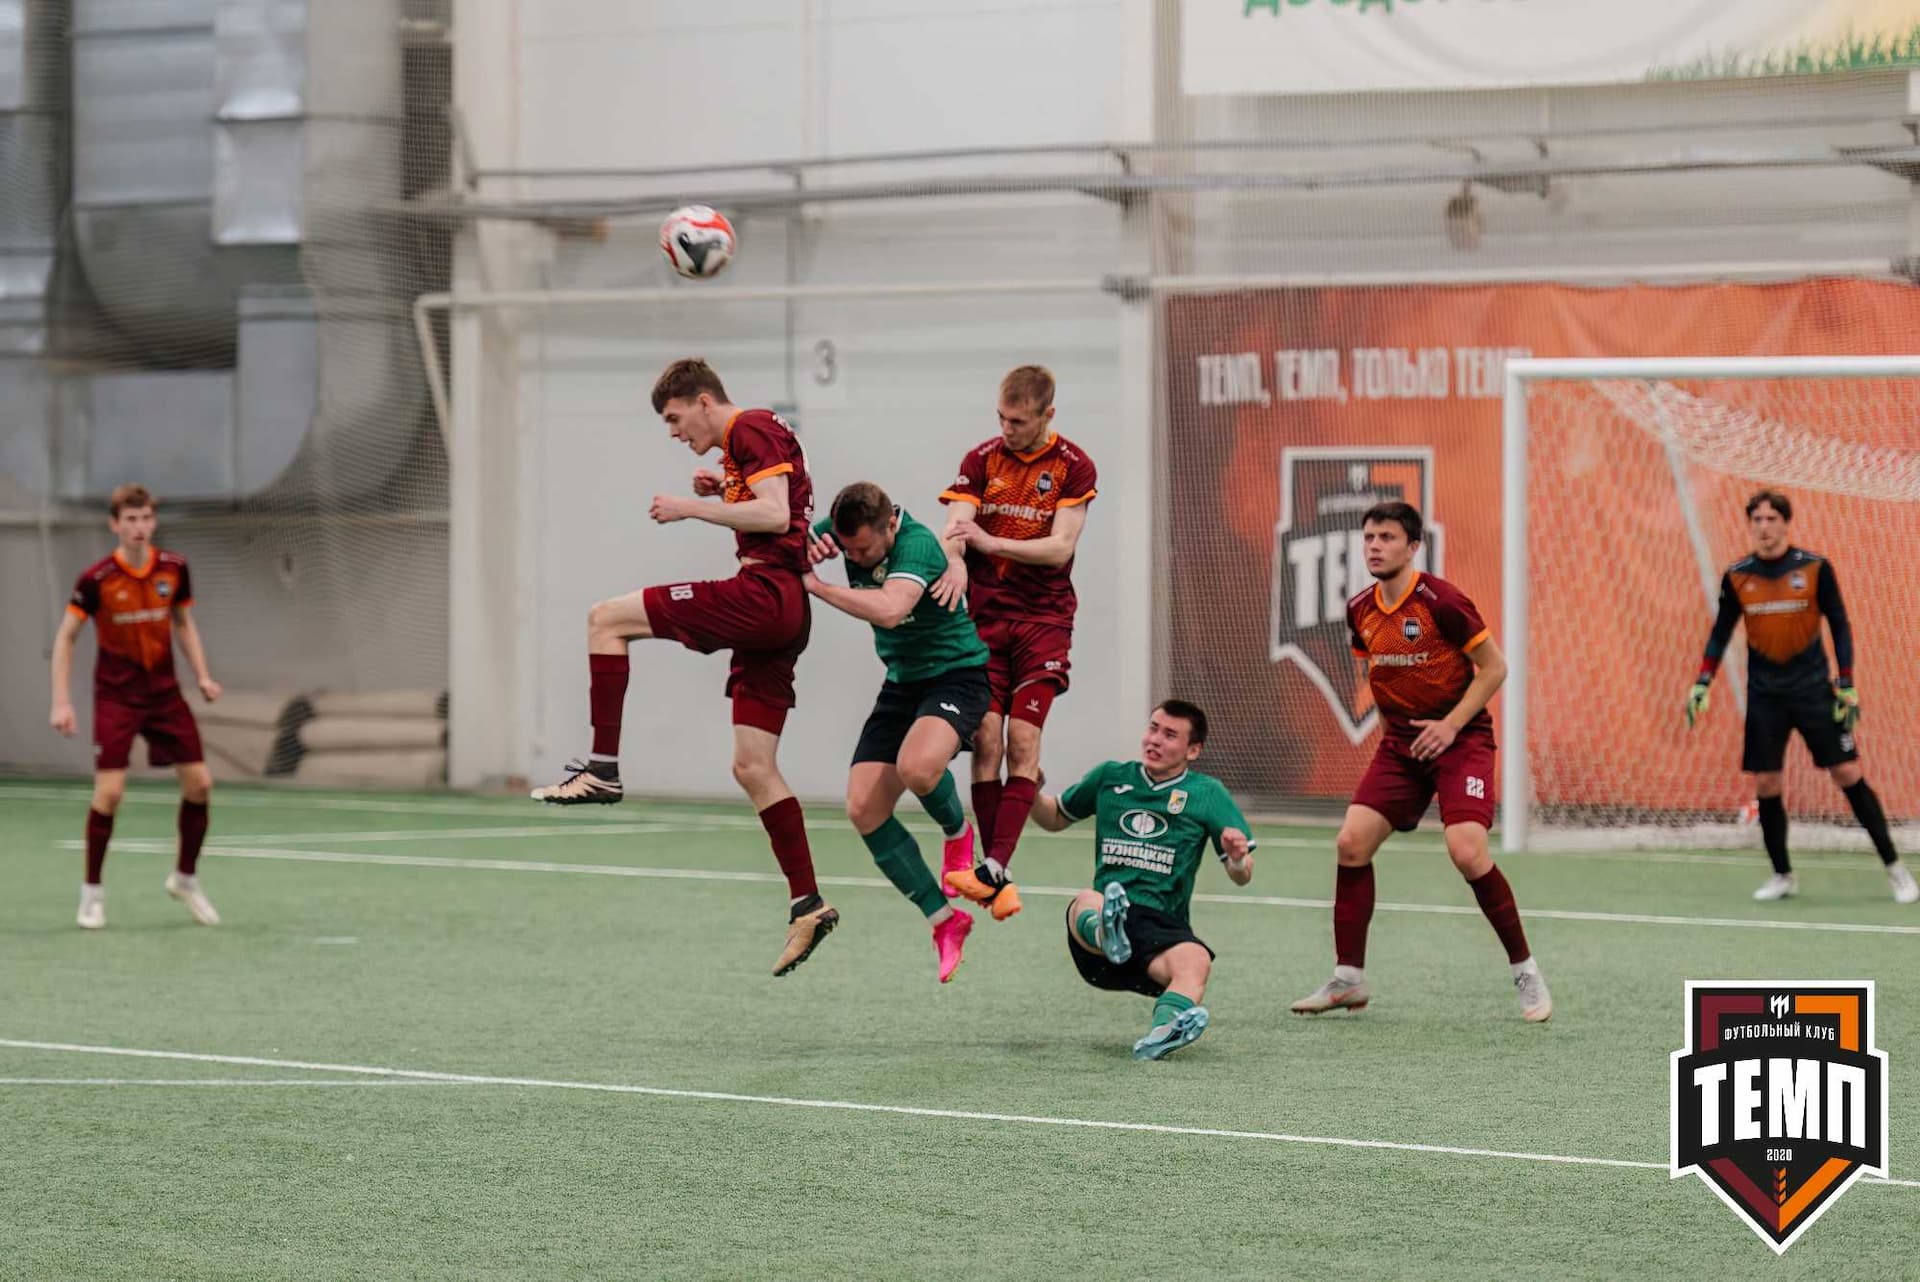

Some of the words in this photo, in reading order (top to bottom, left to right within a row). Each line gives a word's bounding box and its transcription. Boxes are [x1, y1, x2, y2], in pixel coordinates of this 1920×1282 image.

[814, 338, 838, 387] 3
[1198, 353, 1271, 407] ТЕМП,
[1276, 349, 1346, 406] ТЕМП,
[1352, 347, 1447, 399] ТОЛЬКО
[670, 584, 694, 600] 18
[1466, 775, 1485, 800] 22
[1102, 843, 1176, 865] КУЗНЕЦКИЕ
